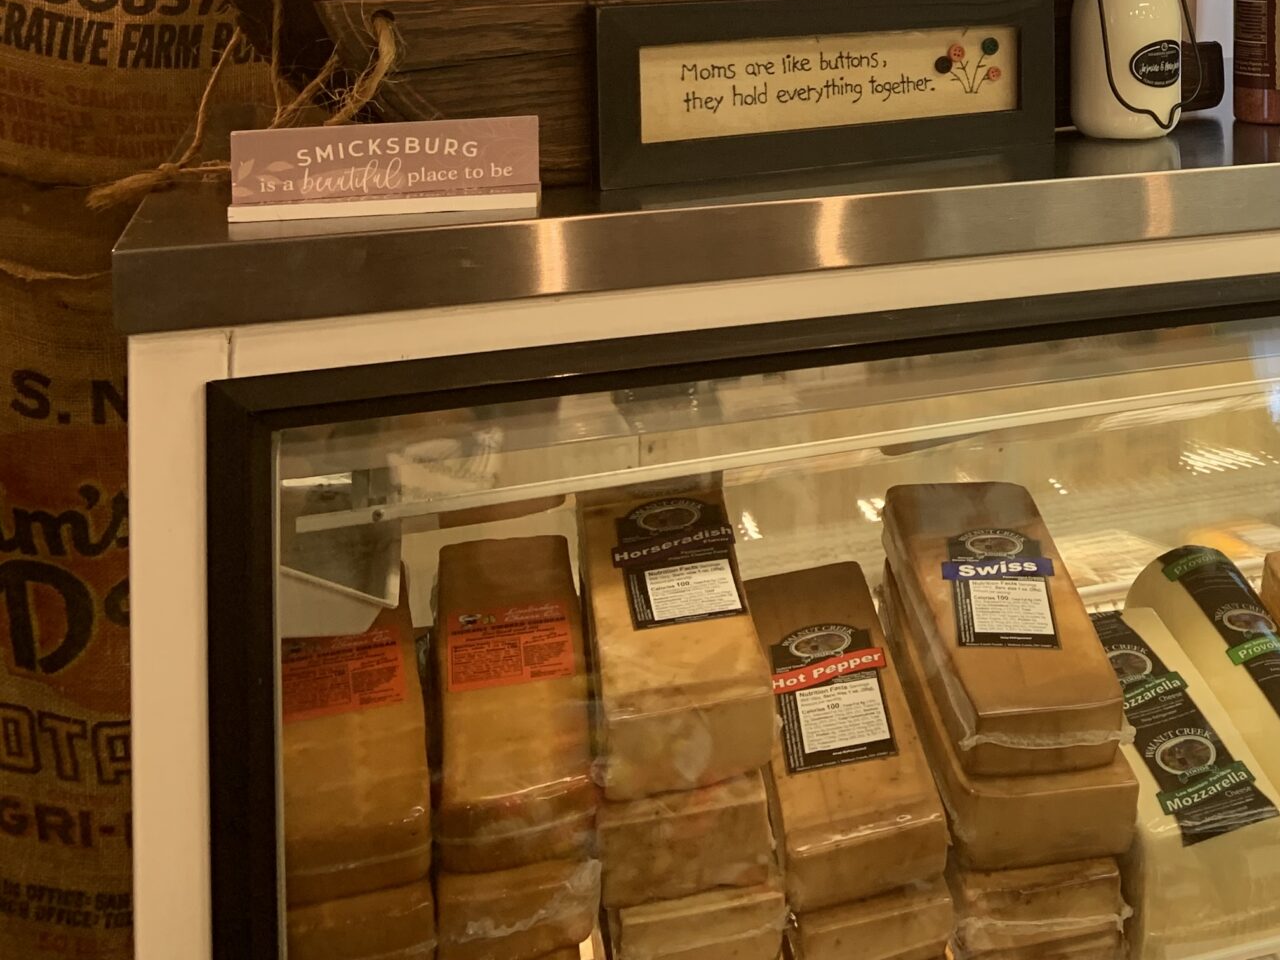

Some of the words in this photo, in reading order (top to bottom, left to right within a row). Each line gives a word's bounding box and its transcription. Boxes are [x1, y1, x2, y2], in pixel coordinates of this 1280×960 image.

[117, 22, 201, 70] FARM
[681, 62, 736, 82] Moms
[745, 60, 776, 76] are
[782, 53, 812, 73] like
[819, 51, 888, 71] buttons,
[683, 91, 724, 114] they
[732, 82, 768, 107] hold
[776, 76, 864, 105] everything
[868, 75, 937, 102] together.
[297, 137, 479, 167] SMICKSBURG
[260, 178, 276, 193] is
[282, 179, 294, 192] a
[300, 157, 402, 194] beautiful
[407, 168, 458, 186] place
[465, 166, 484, 179] to
[491, 163, 513, 178] be
[614, 526, 732, 561] Horseradish
[958, 560, 1037, 577] Swiss
[819, 625, 856, 634] CREEK
[772, 673, 806, 689] Hot
[812, 652, 881, 679] Pepper
[1123, 679, 1181, 710] ozzarella
[1145, 730, 1174, 758] WALNUT
[1175, 727, 1212, 739] CREEK
[1166, 771, 1248, 811] Mozzarella
